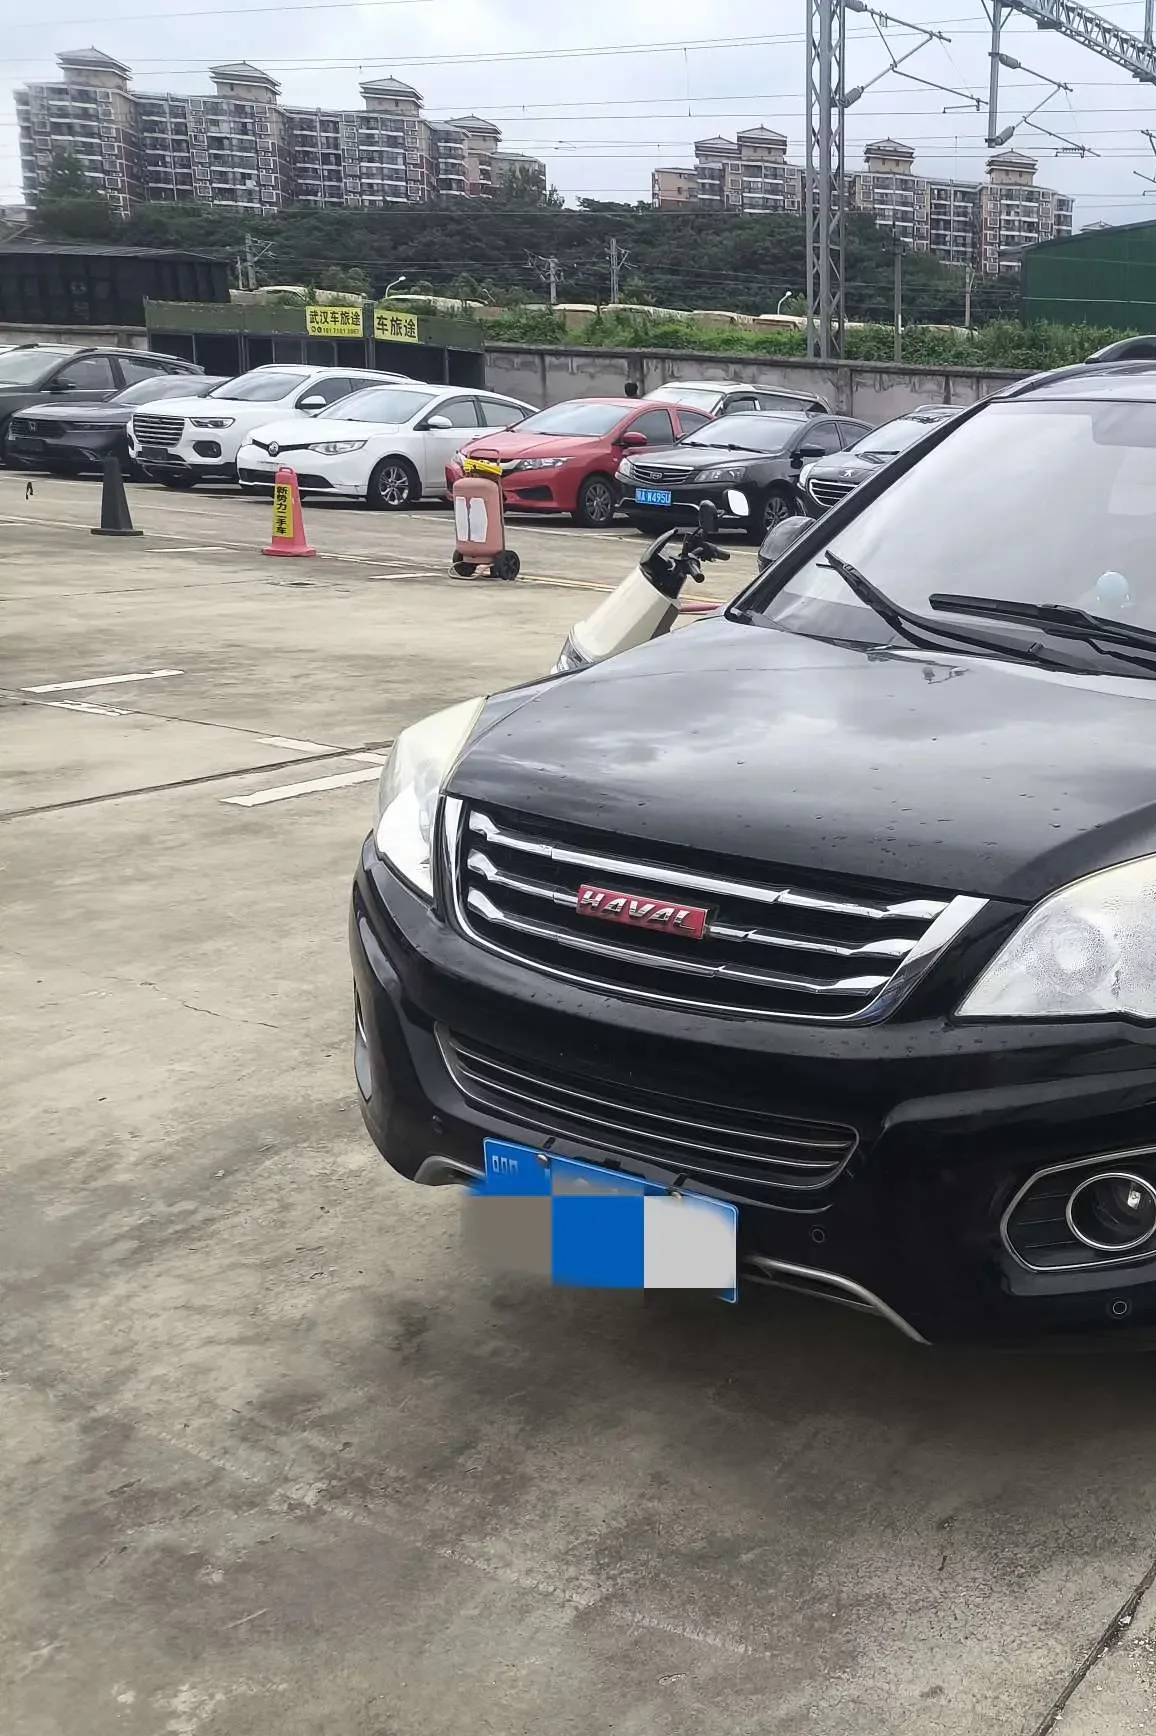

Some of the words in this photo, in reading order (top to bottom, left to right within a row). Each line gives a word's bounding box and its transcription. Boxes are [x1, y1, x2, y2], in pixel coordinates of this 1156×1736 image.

[309, 310, 361, 326] 武汉车旅途
[376, 315, 417, 339] 车旅途
[275, 486, 288, 535] 新势力二手车
[580, 890, 697, 930] HAVAL
